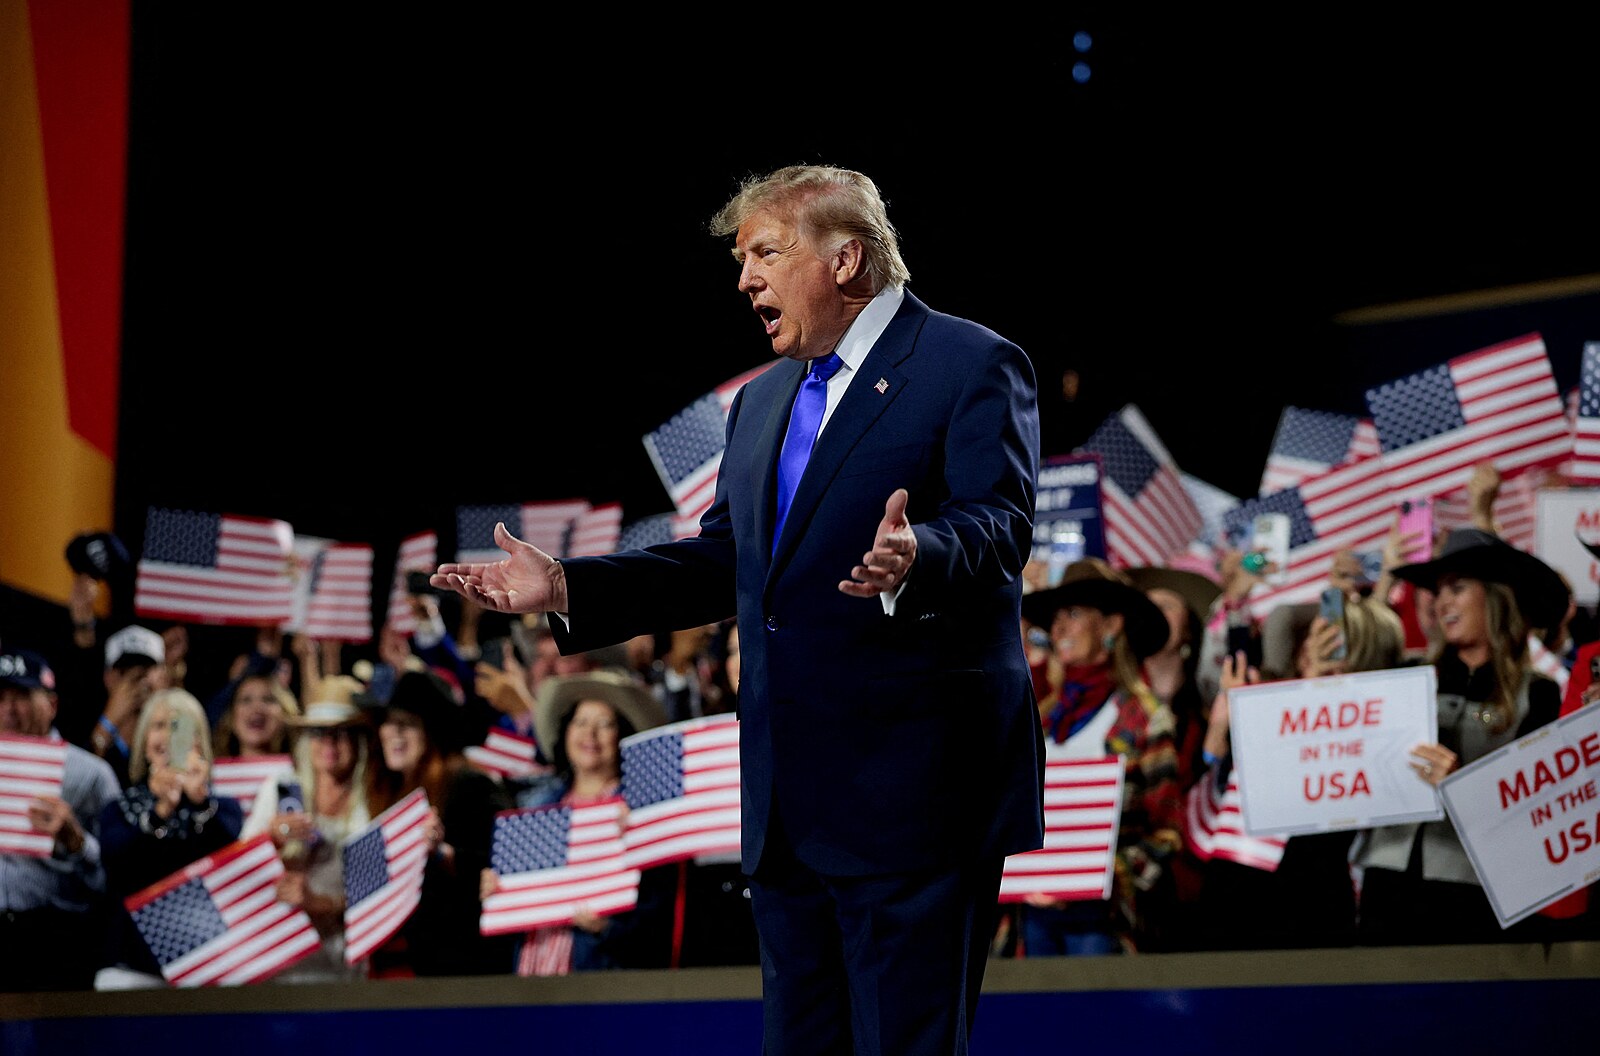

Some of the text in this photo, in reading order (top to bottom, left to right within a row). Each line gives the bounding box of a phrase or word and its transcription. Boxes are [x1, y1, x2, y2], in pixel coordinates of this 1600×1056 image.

[1280, 698, 1383, 735] MADE
[1301, 740, 1363, 761] IN THE
[1498, 732, 1600, 810] MADE
[1303, 769, 1371, 803] USA
[1531, 780, 1598, 827] IN THE
[1544, 811, 1600, 864] US
